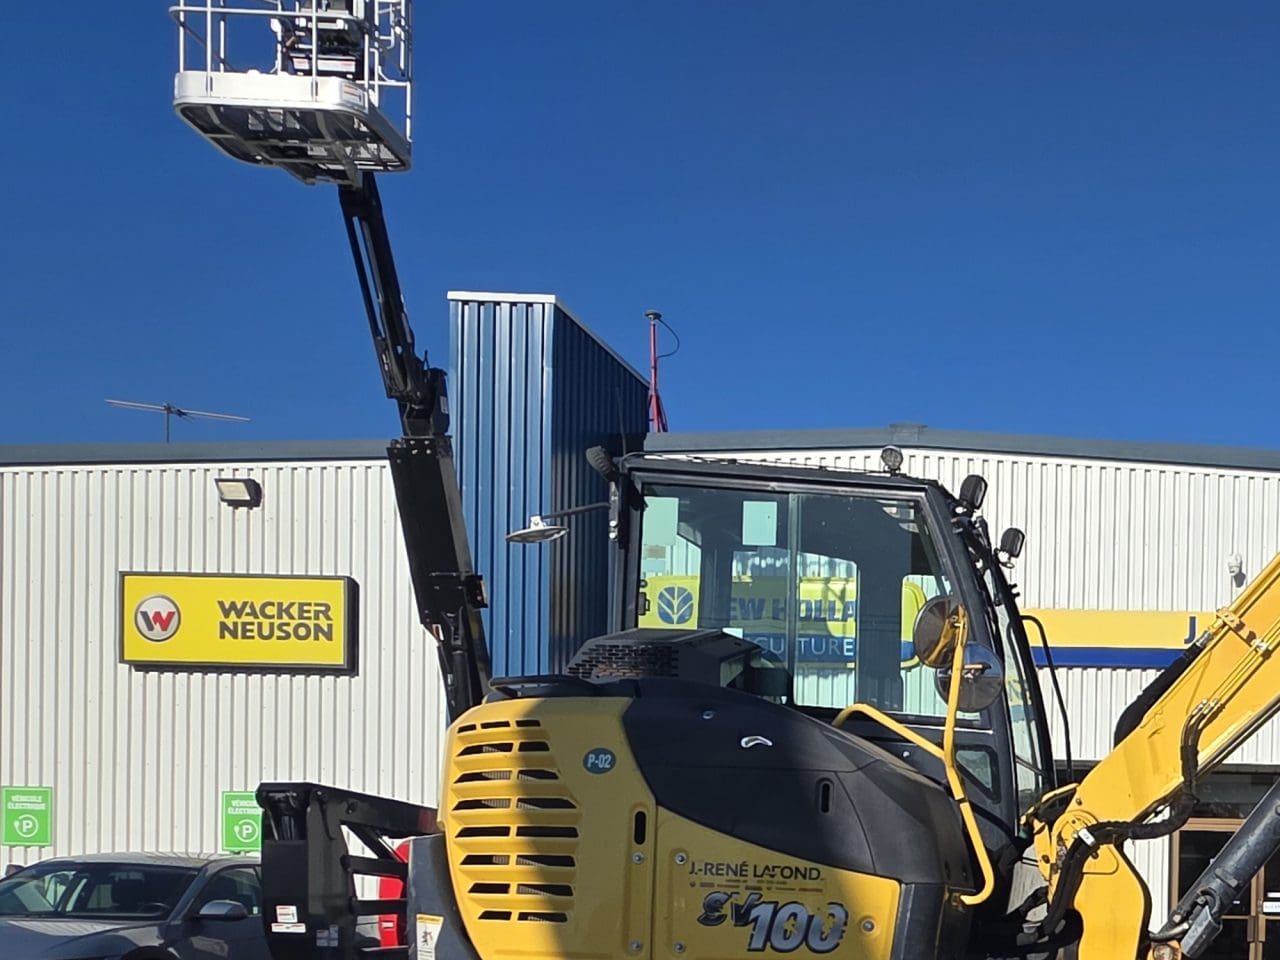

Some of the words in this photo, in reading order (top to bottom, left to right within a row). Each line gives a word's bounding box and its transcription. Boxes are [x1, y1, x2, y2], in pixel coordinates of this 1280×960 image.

[217, 600, 334, 621] WACKER
[218, 621, 333, 641] NEUSON
[587, 753, 612, 769] P-02
[689, 861, 749, 877] J.-RENÉ
